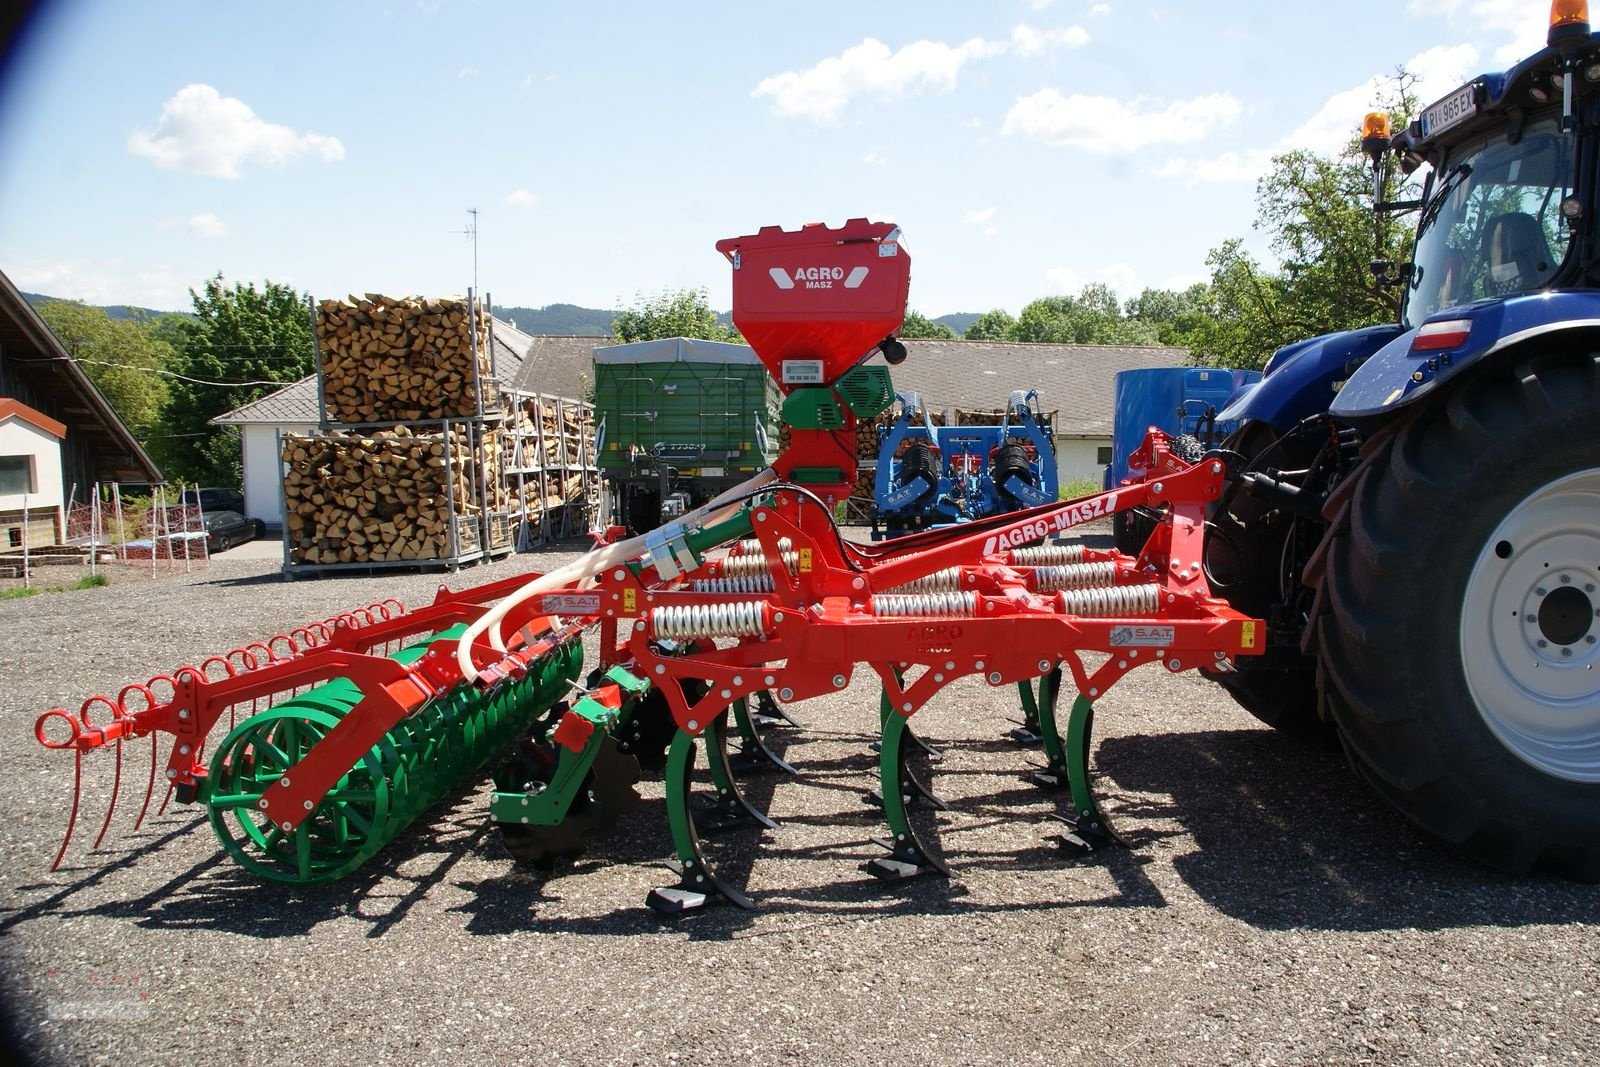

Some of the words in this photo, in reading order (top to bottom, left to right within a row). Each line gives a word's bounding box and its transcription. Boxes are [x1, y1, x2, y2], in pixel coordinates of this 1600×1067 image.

[1429, 110, 1439, 131] RI
[1443, 97, 1460, 122] 965
[1460, 90, 1472, 112] EX
[795, 266, 845, 281] AGRO
[805, 281, 833, 289] MASZ
[998, 500, 1105, 551] AGRO-MASZ
[564, 597, 598, 605] S.A.T.
[1135, 628, 1172, 638] S.A.T.
